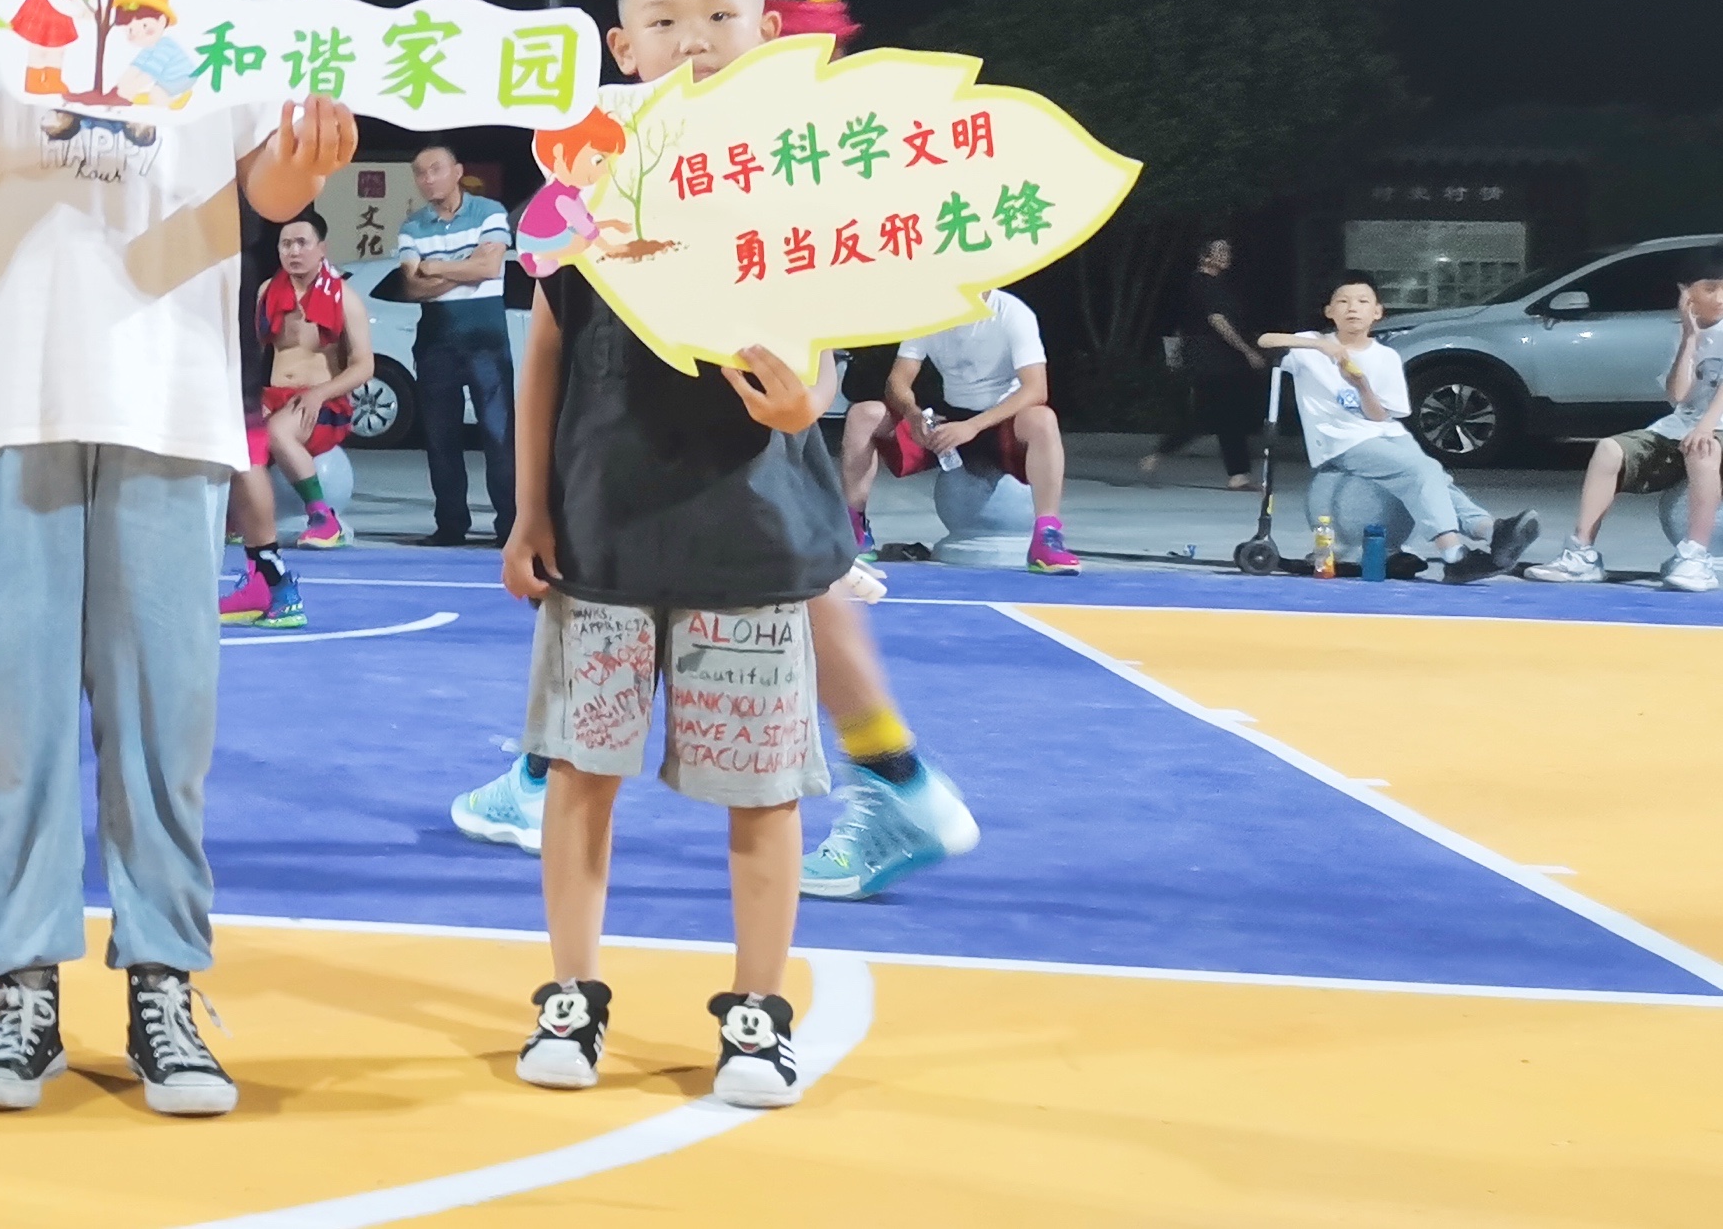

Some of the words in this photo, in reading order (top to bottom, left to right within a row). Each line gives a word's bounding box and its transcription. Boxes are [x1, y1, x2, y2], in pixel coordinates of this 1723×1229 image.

[190, 10, 579, 113] 和谐家园
[668, 111, 995, 202] 倡导科学文明
[355, 204, 386, 259] 文化
[733, 180, 1056, 285] 勇当反邪先锋
[688, 611, 793, 647] ALOHA
[673, 717, 728, 741] HAVE
[731, 724, 752, 744] A
